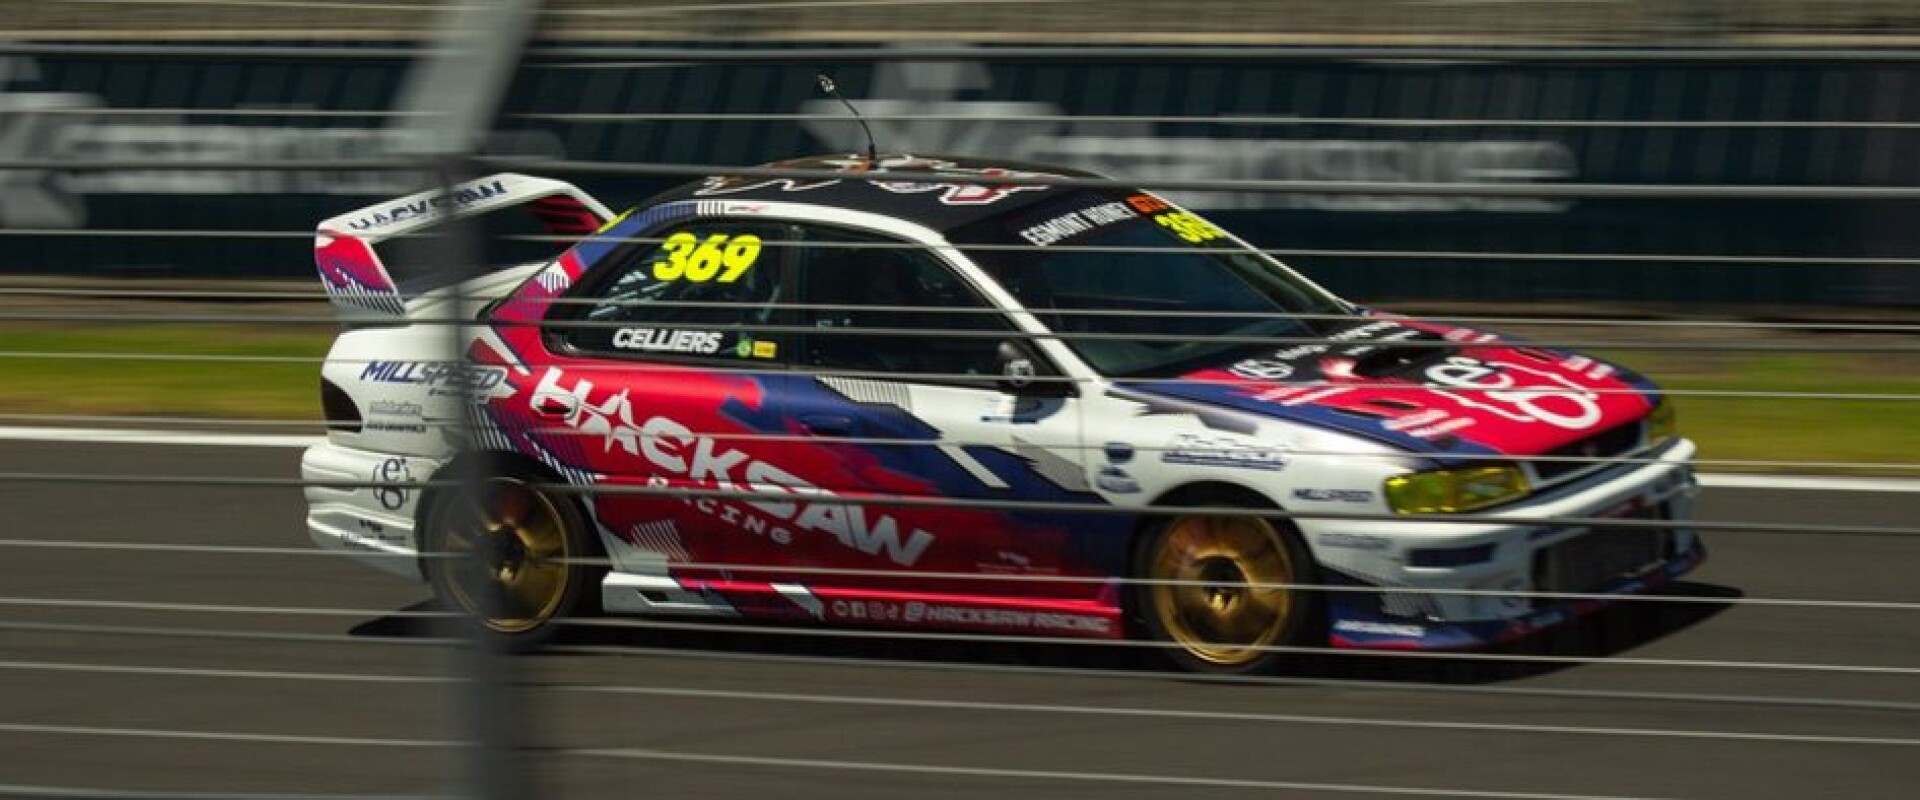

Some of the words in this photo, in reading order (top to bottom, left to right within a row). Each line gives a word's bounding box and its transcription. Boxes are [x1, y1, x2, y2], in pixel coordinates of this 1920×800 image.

[653, 232, 762, 283] 369
[613, 328, 724, 354] CELLIERS
[530, 366, 936, 567] HACKSAW
